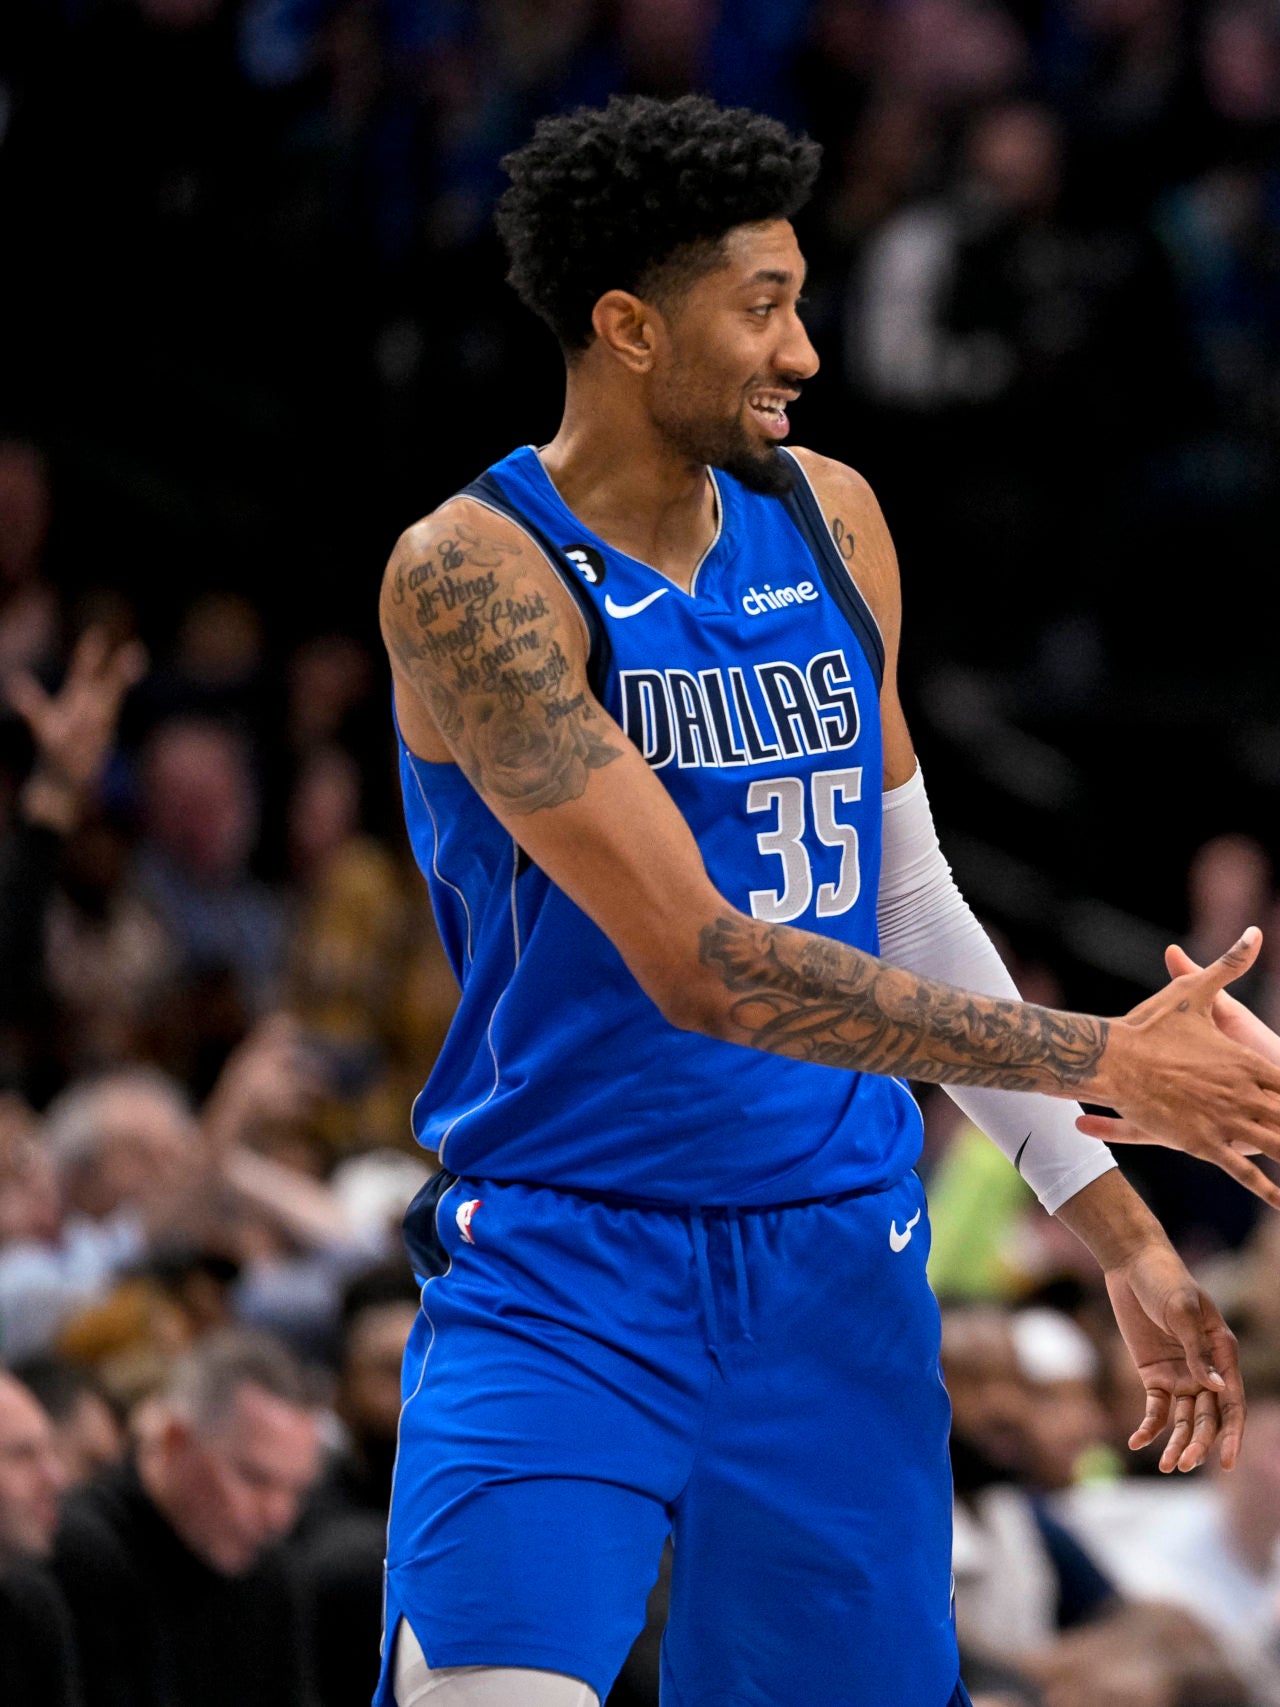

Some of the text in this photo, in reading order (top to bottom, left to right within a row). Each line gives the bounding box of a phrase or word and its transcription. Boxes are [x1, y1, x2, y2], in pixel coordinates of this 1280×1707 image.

[742, 580, 819, 616] chime
[619, 649, 861, 770] DALLAS
[746, 766, 863, 923] 35
